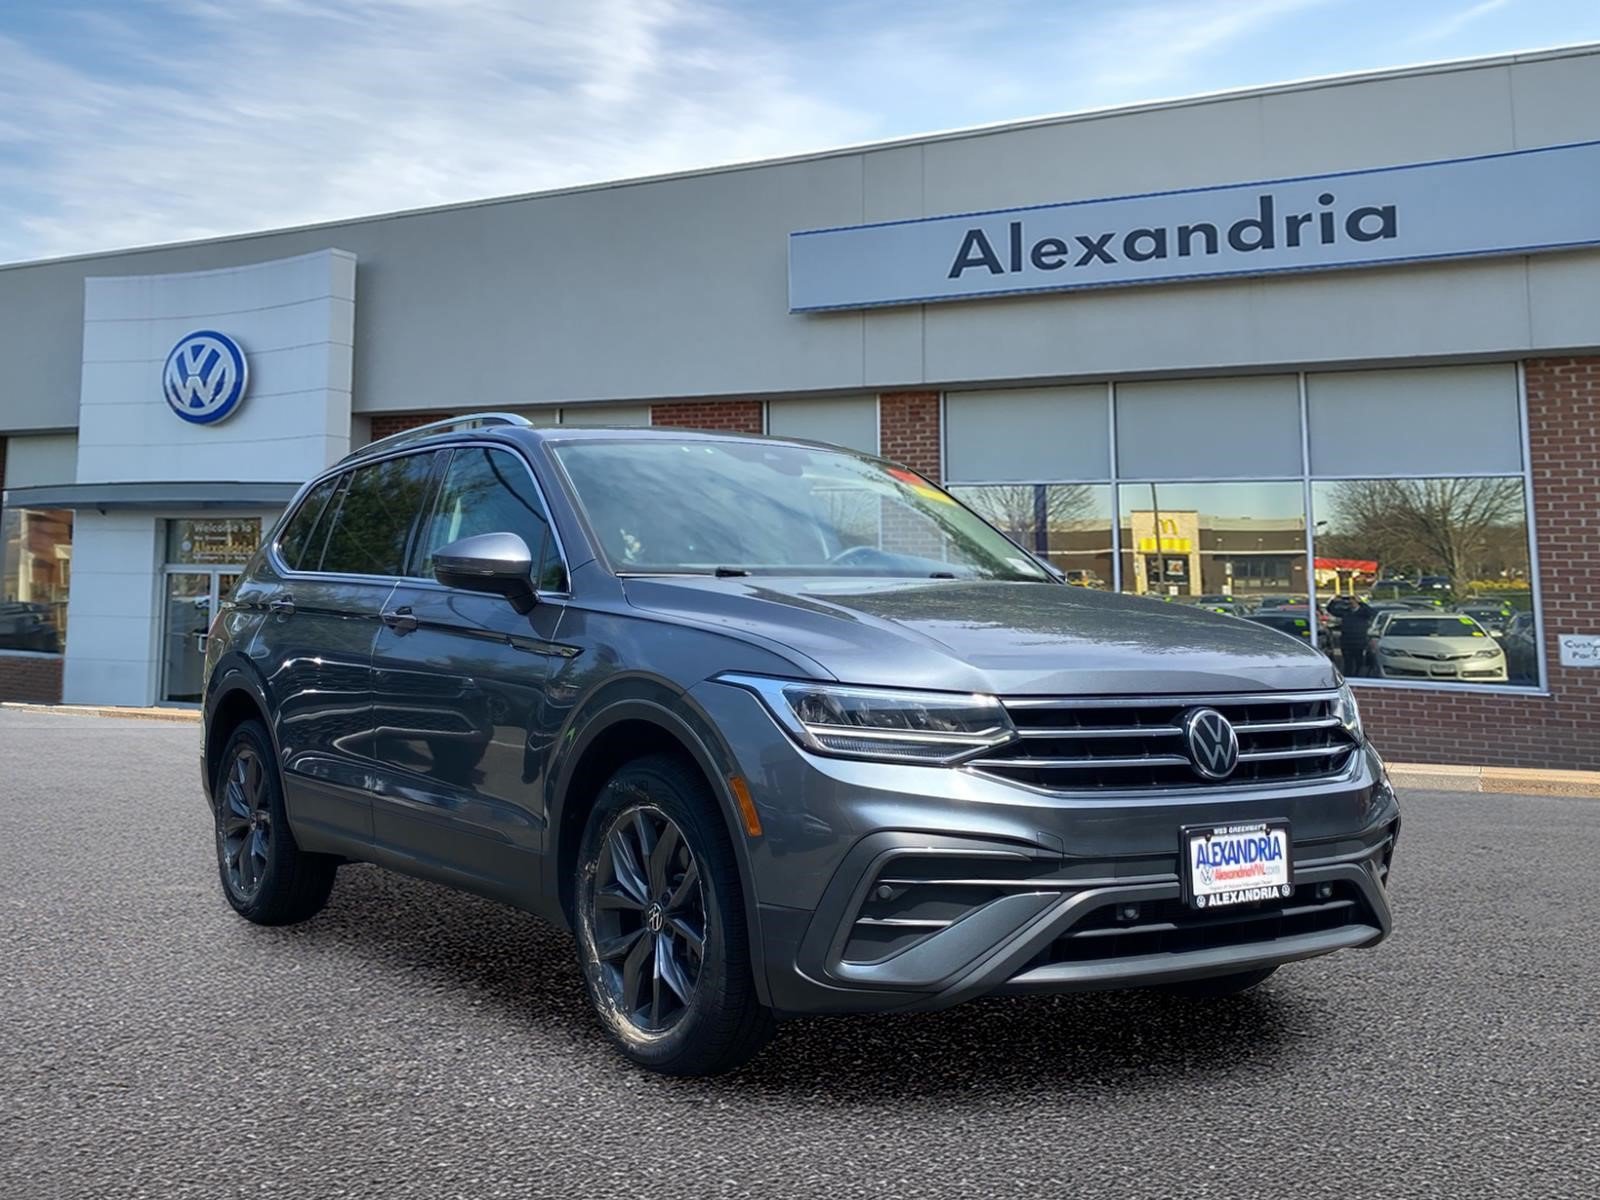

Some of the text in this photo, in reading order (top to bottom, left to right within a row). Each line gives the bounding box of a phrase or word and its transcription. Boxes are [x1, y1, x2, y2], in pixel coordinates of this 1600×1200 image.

[948, 193, 1397, 279] Alexandria
[1196, 836, 1282, 869] ALEXANDRIA
[1208, 886, 1280, 907] ALEXANDRIA
